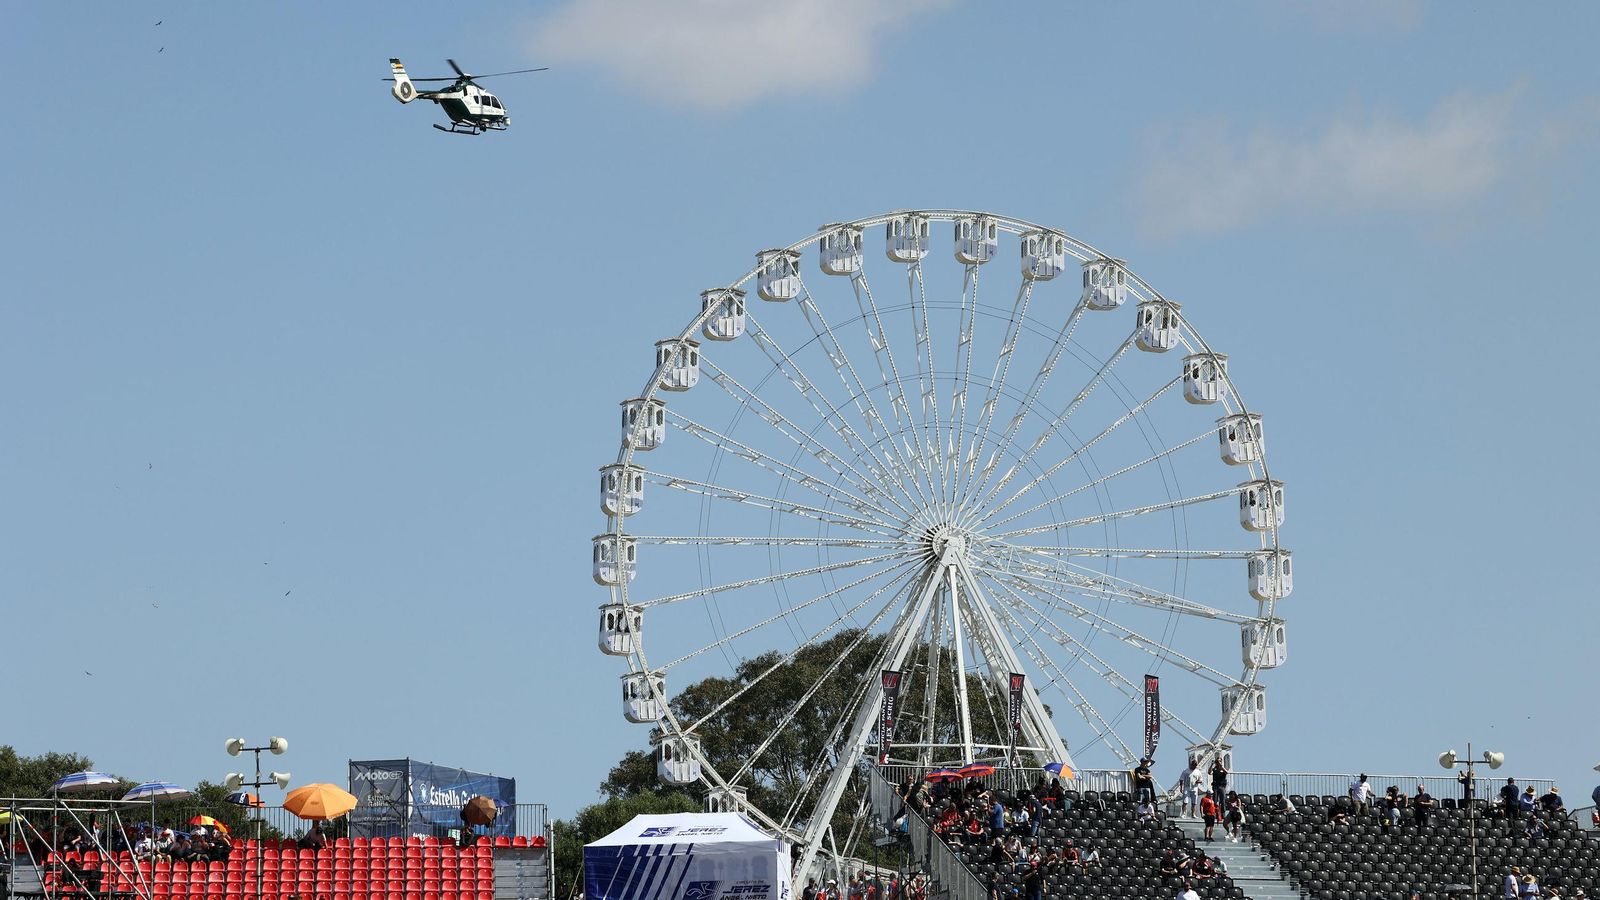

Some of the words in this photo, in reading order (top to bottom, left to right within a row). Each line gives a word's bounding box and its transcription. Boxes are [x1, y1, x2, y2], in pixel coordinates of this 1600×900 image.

[354, 770, 404, 781] MotoGP
[430, 785, 460, 805] Estrella
[722, 884, 771, 893] JEREZ
